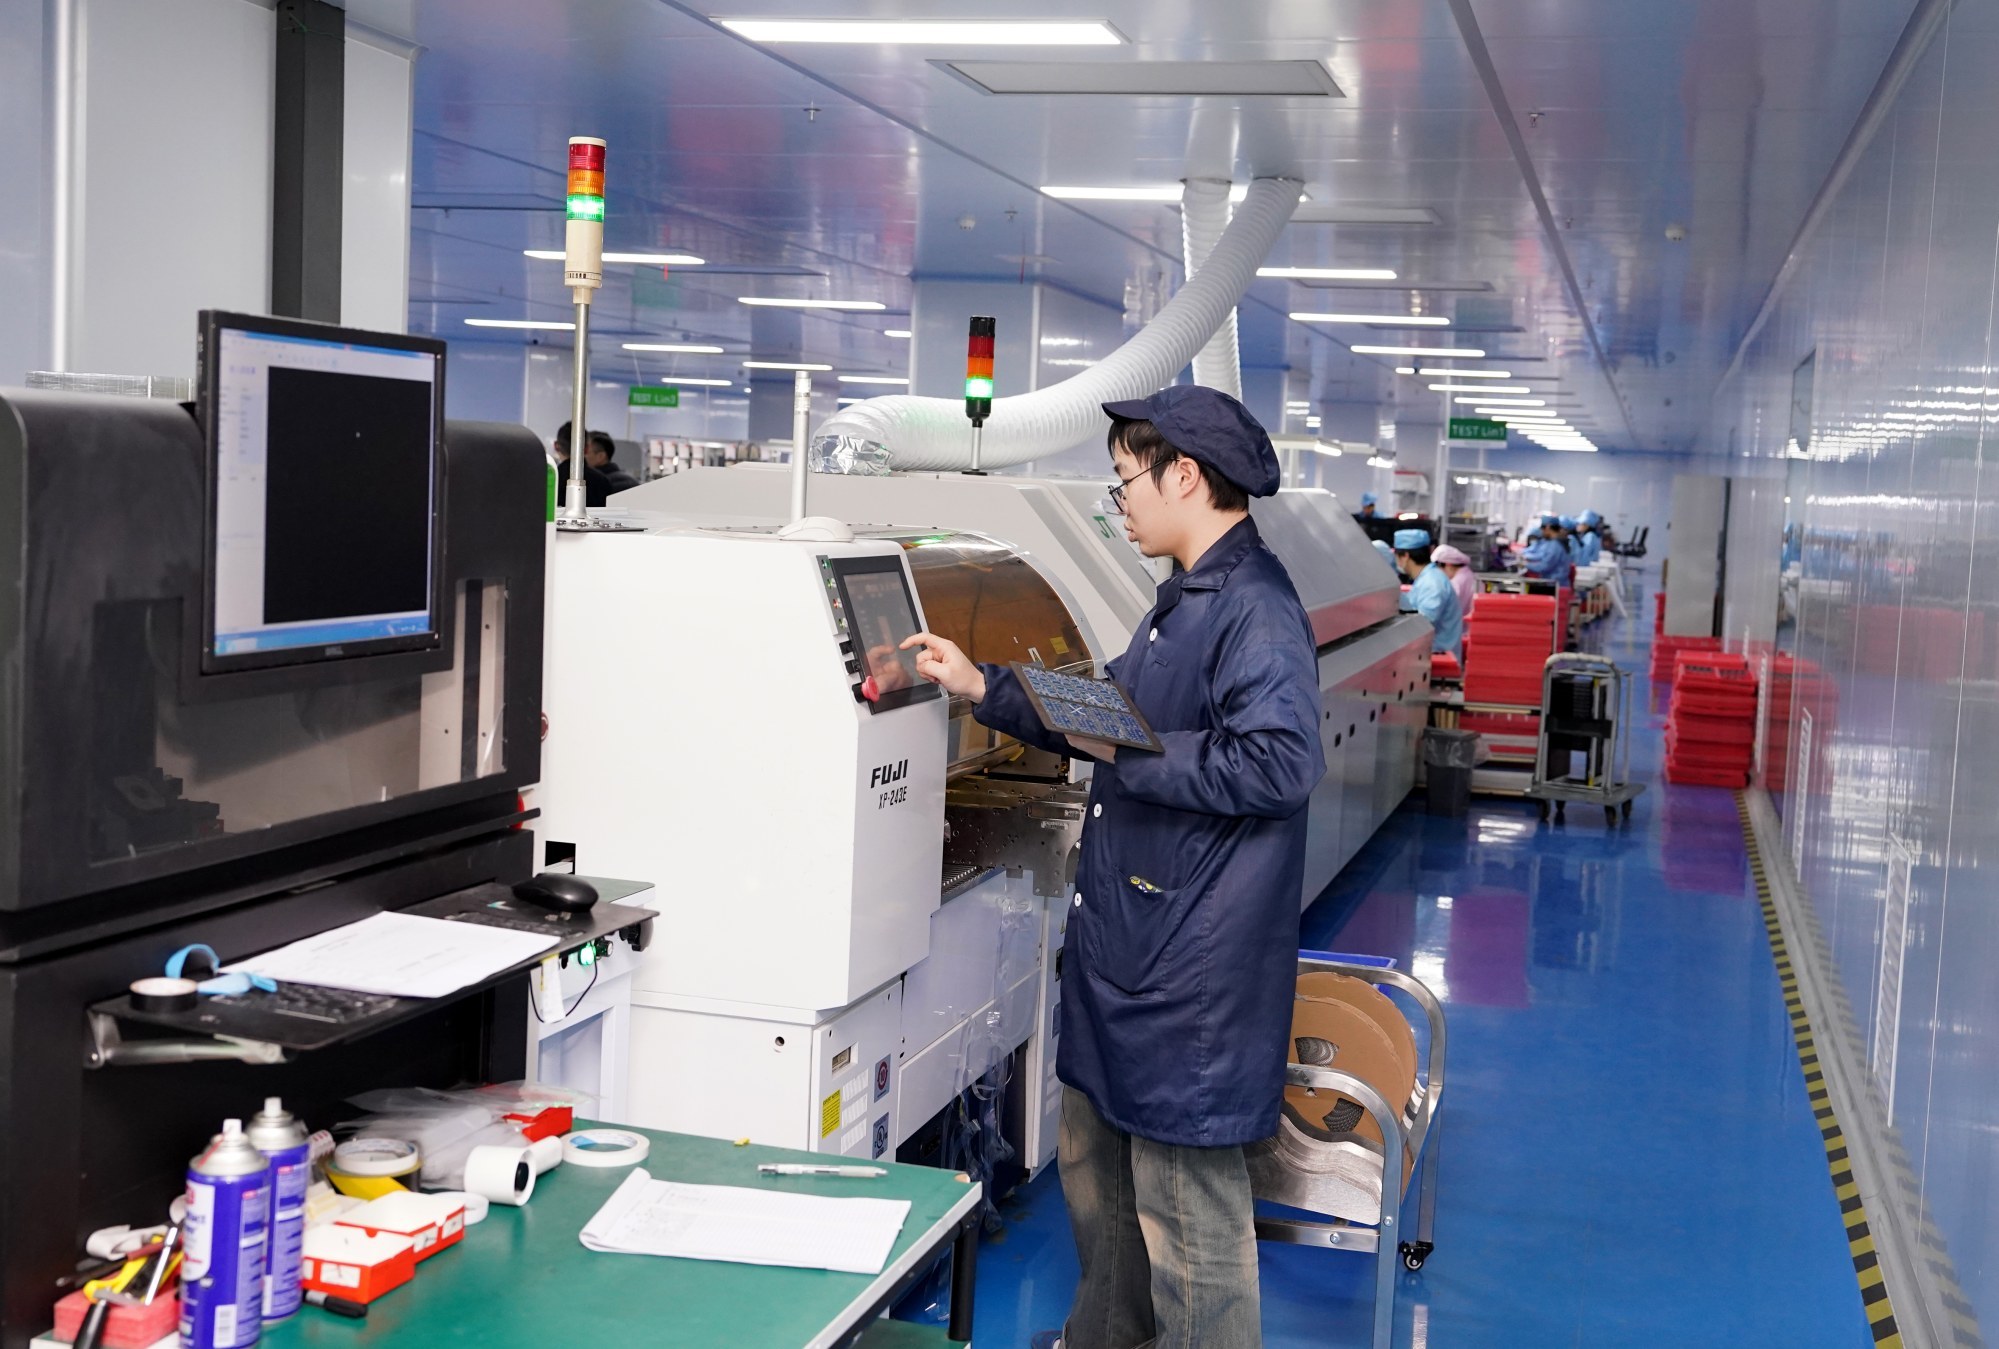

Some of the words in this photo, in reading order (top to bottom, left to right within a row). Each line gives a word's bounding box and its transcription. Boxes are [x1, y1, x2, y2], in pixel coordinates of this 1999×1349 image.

[1452, 425, 1479, 437] TEST
[870, 758, 909, 789] FUJI
[878, 786, 908, 810] XP-243E
